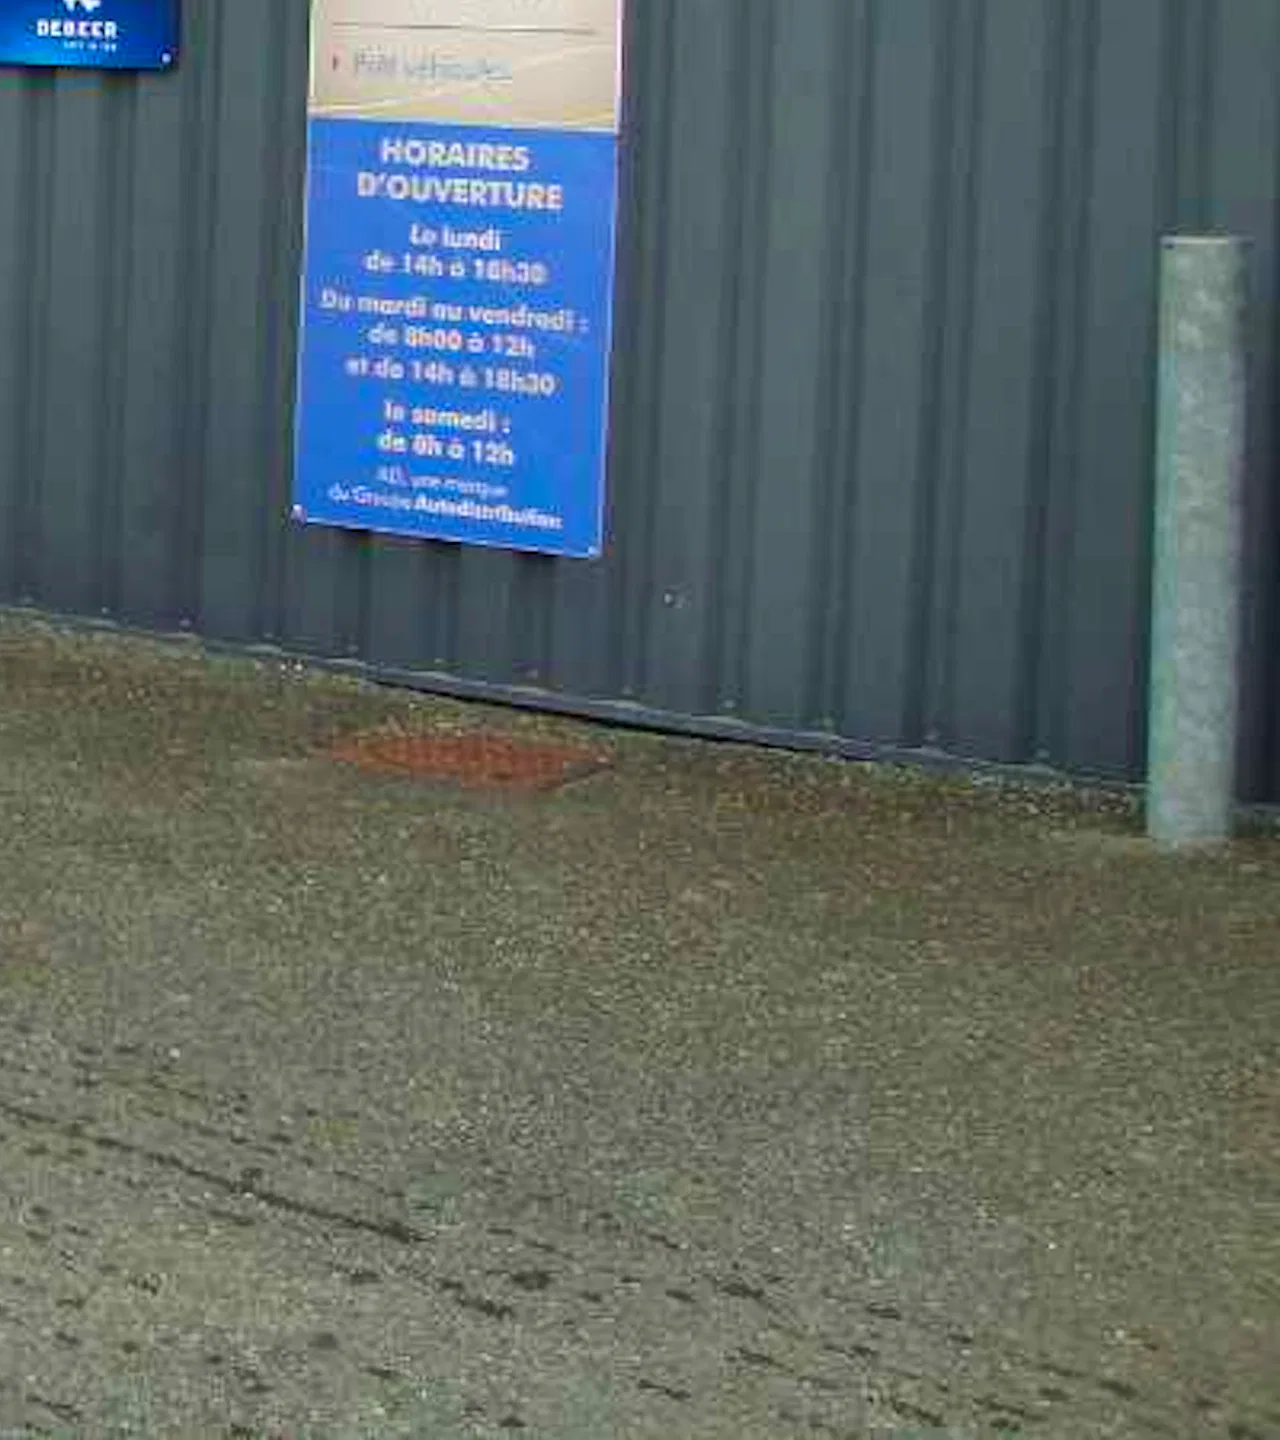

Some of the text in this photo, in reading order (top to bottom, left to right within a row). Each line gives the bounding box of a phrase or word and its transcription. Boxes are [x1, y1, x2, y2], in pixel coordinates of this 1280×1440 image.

[380, 138, 530, 171] HORAIRES
[357, 174, 564, 210] D'OUVERTURE
[442, 224, 501, 252] lundi
[364, 251, 394, 274] de
[401, 253, 443, 278] 14h
[473, 259, 548, 285] 18h30
[319, 289, 351, 312] Du
[357, 295, 427, 320] mardi
[434, 303, 464, 323] au
[368, 325, 399, 347] de
[492, 334, 536, 359] 12h
[345, 359, 370, 379] et
[373, 359, 404, 381] de
[411, 361, 454, 386] 14h
[483, 368, 557, 397] 18h30
[411, 406, 498, 433] samedi
[377, 431, 407, 454] de
[473, 441, 515, 467] 12h
